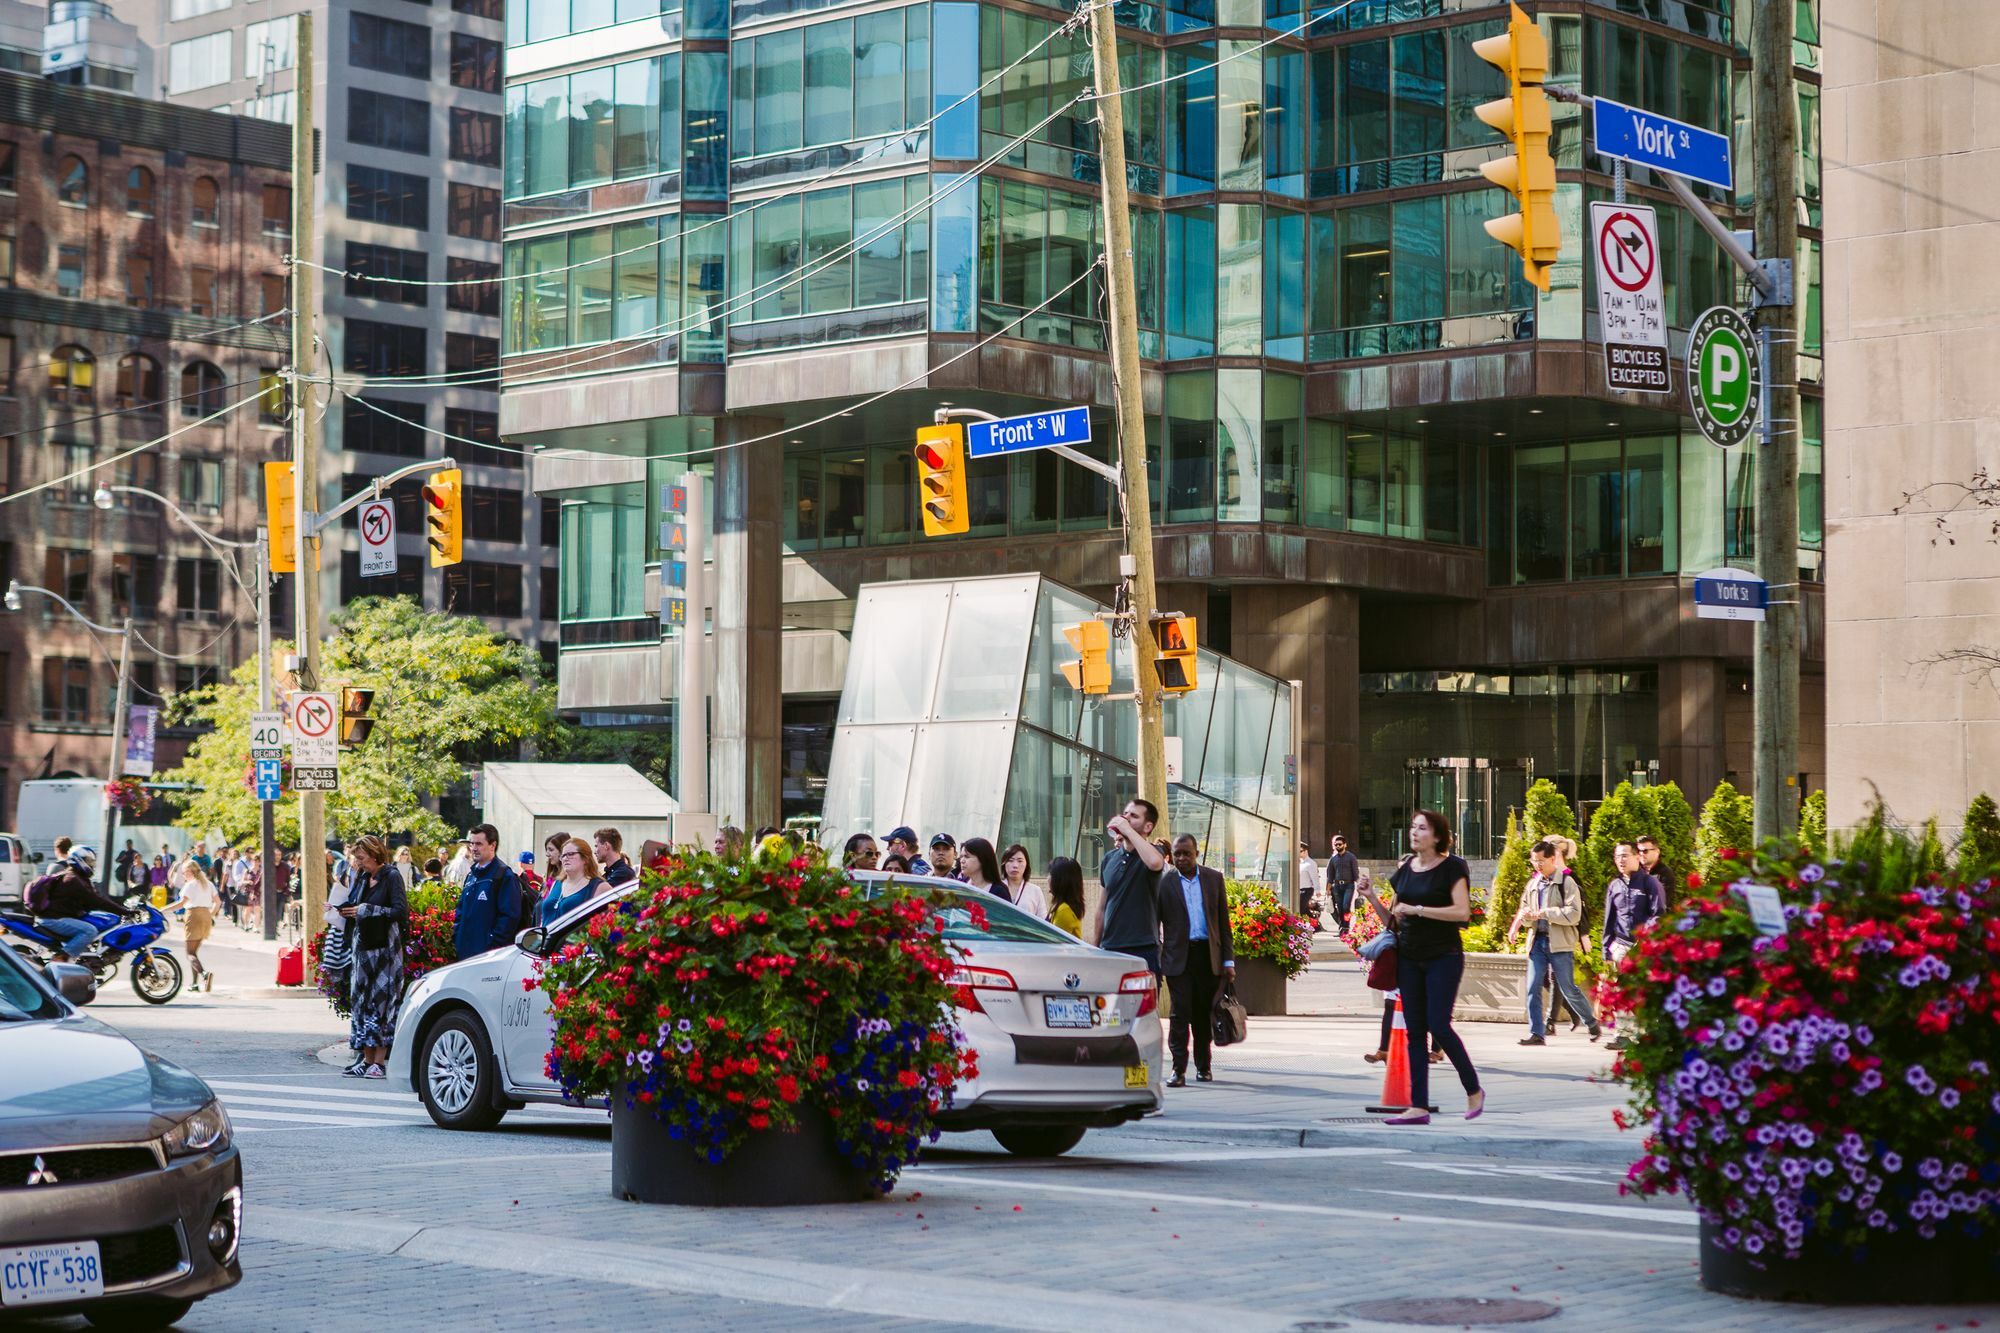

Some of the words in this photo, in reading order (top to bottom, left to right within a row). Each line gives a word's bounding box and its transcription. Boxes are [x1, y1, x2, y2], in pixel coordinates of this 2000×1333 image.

[1632, 115, 1676, 160] York
[1679, 130, 1691, 149] St
[1604, 291, 1623, 310] 7AM
[1634, 293, 1658, 312] 10AM
[1607, 311, 1627, 328] 3PM
[1640, 313, 1659, 330] 7PM
[1692, 315, 1758, 377] MUNICIPAL
[1612, 349, 1662, 367] BICYCLES
[1611, 367, 1666, 385] EXCEPTED
[1712, 343, 1740, 395] P
[1692, 385, 1757, 441] PARKING
[990, 420, 1034, 446] Front
[1037, 417, 1047, 430] St
[1051, 414, 1066, 437] W
[374, 551, 383, 560] TO
[671, 489, 685, 621] PATH
[364, 562, 383, 572] FRONT
[1717, 582, 1739, 600] York
[1740, 587, 1749, 601] St
[254, 728, 279, 745] 40
[317, 738, 333, 747] 10AM
[253, 749, 281, 758] BEGINS
[296, 748, 310, 757] 3PM
[320, 748, 333, 757] 7PM
[259, 763, 278, 781] H
[297, 770, 334, 778] BICYCLES
[30, 1249, 69, 1259] ONTARIO
[5, 1260, 49, 1290] CCYF
[63, 1255, 98, 1284] 538
